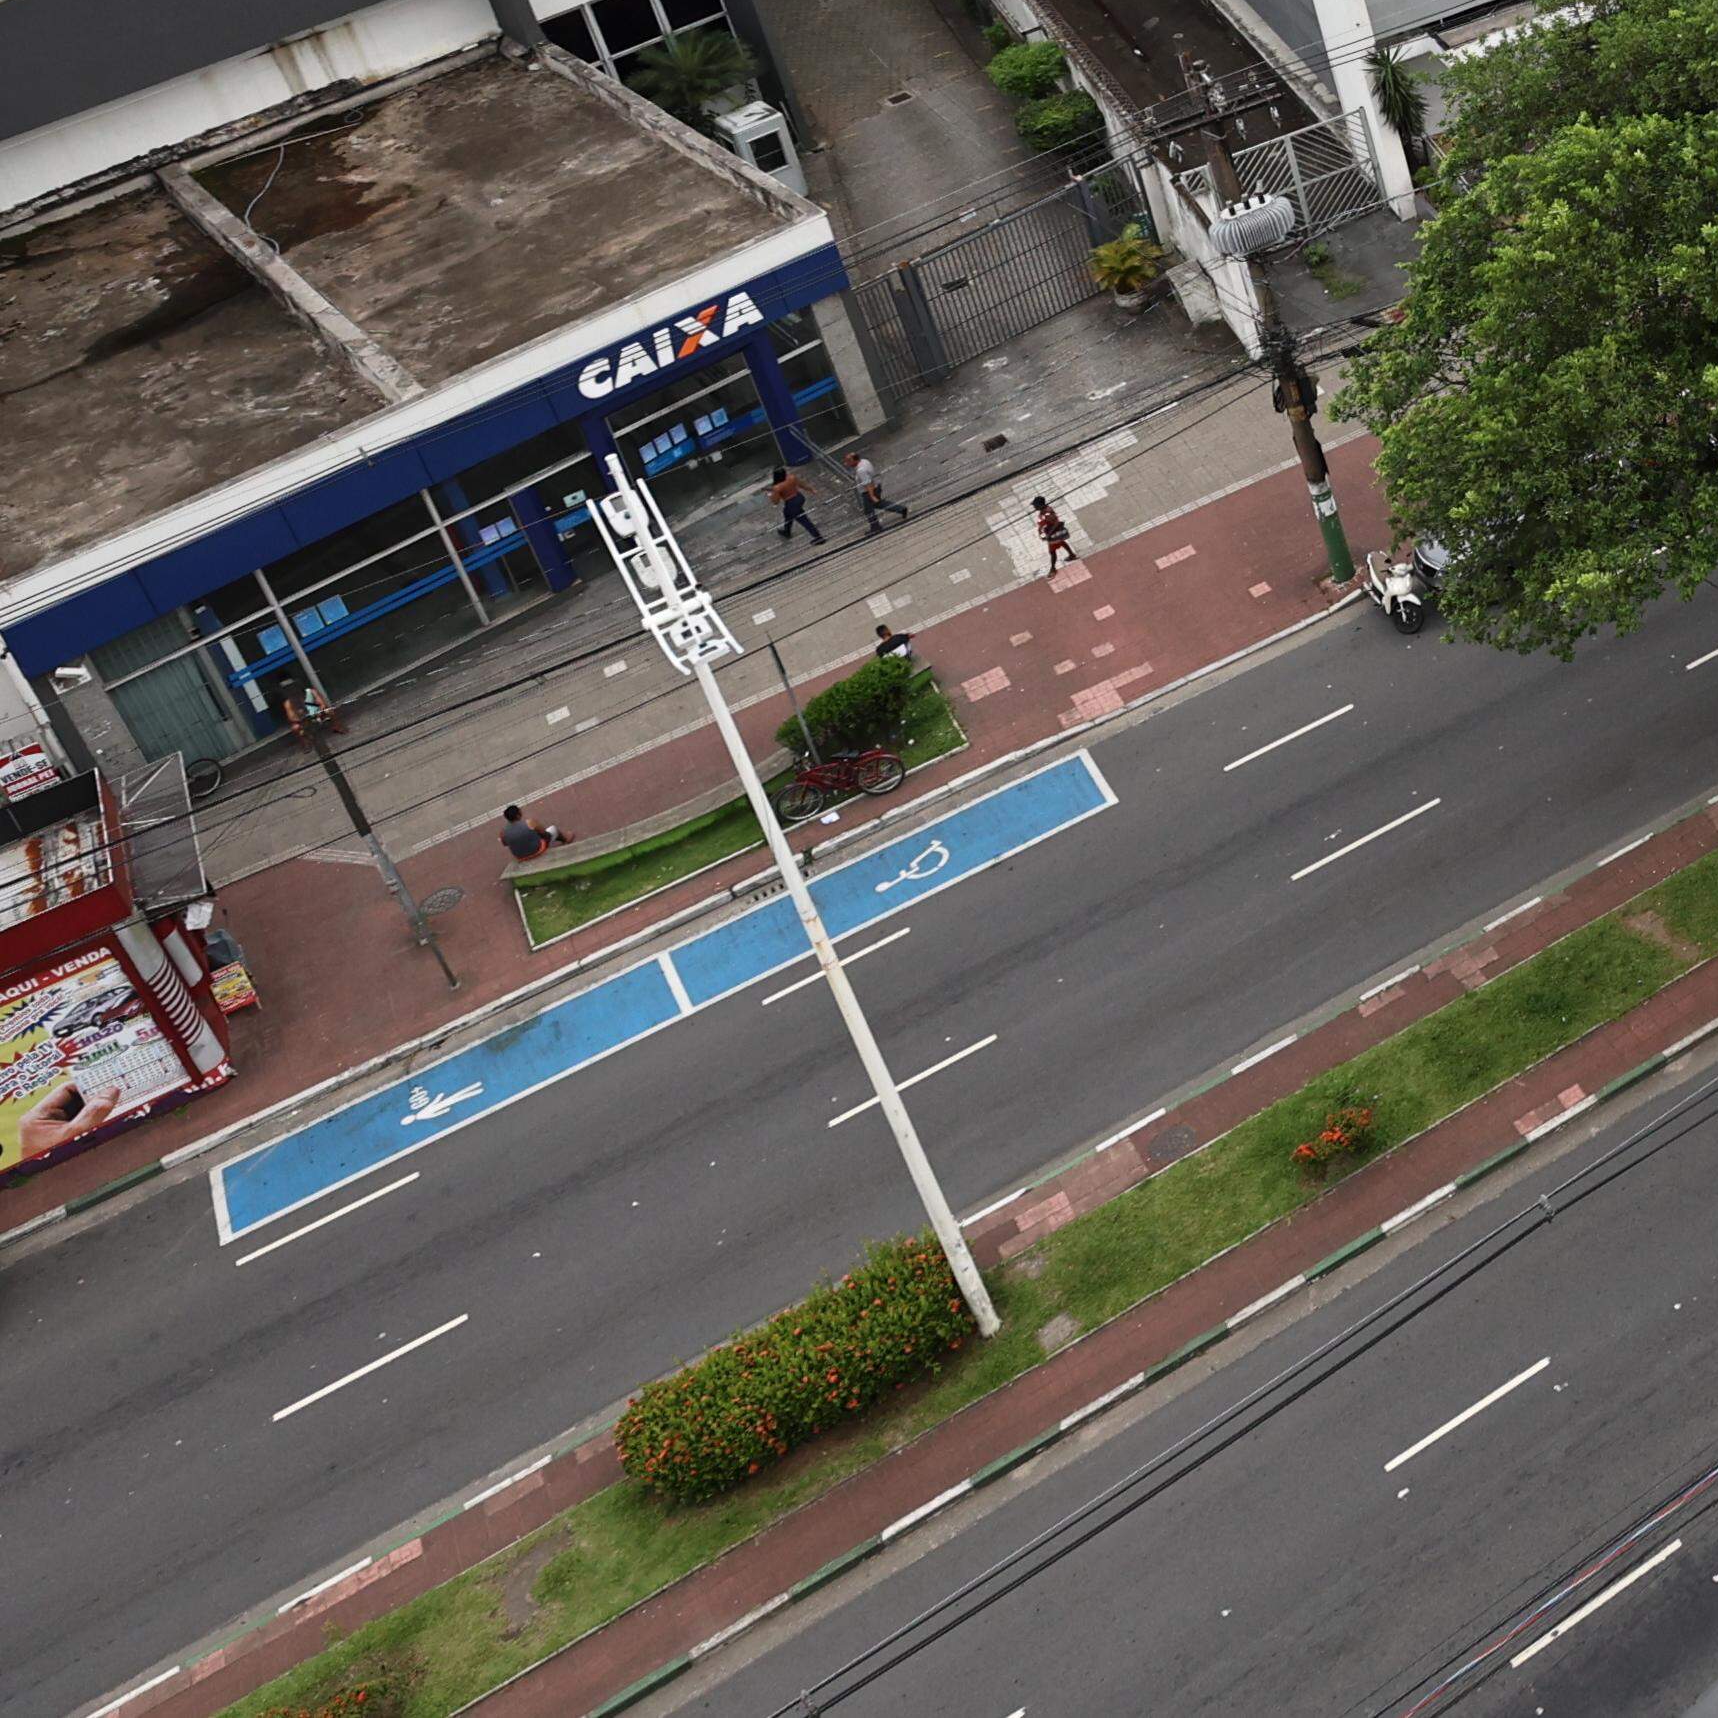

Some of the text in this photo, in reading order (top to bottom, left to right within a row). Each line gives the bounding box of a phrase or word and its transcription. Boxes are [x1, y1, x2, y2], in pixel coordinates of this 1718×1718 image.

[577, 291, 764, 400] CAIXA
[0, 758, 49, 785] VENDE-SE
[0, 978, 39, 1003] AQUI
[51, 946, 113, 977] VENDA
[19, 1049, 41, 1072] pela
[41, 1040, 54, 1056] TV
[26, 1051, 63, 1078] Litoral
[14, 1089, 24, 1100] e
[23, 1066, 60, 1094] Região
